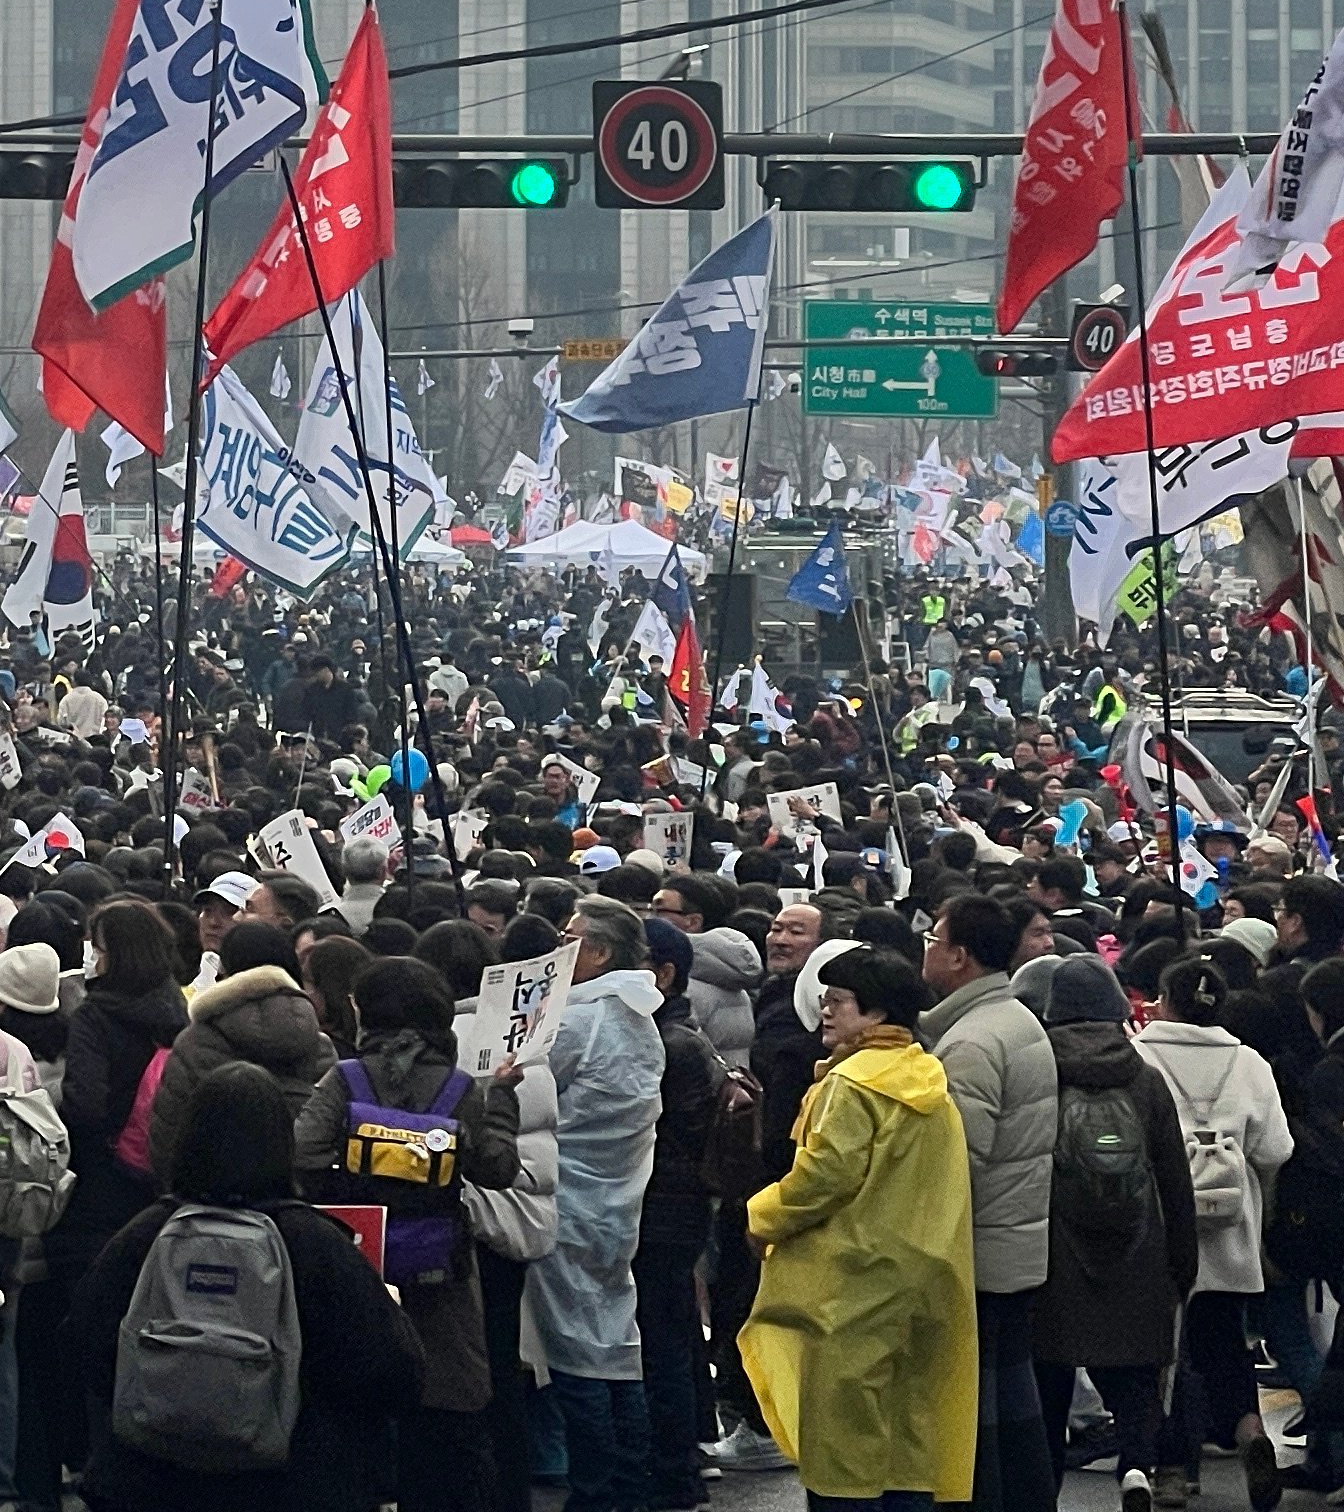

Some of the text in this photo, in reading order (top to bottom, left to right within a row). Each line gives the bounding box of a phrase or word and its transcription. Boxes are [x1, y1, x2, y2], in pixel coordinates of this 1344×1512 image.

[627, 120, 689, 172] 40
[875, 308, 929, 326] 수색역
[1085, 325, 1115, 353] 40
[811, 366, 845, 384] 시청
[811, 386, 868, 400] City Hall
[916, 398, 949, 412] 100m
